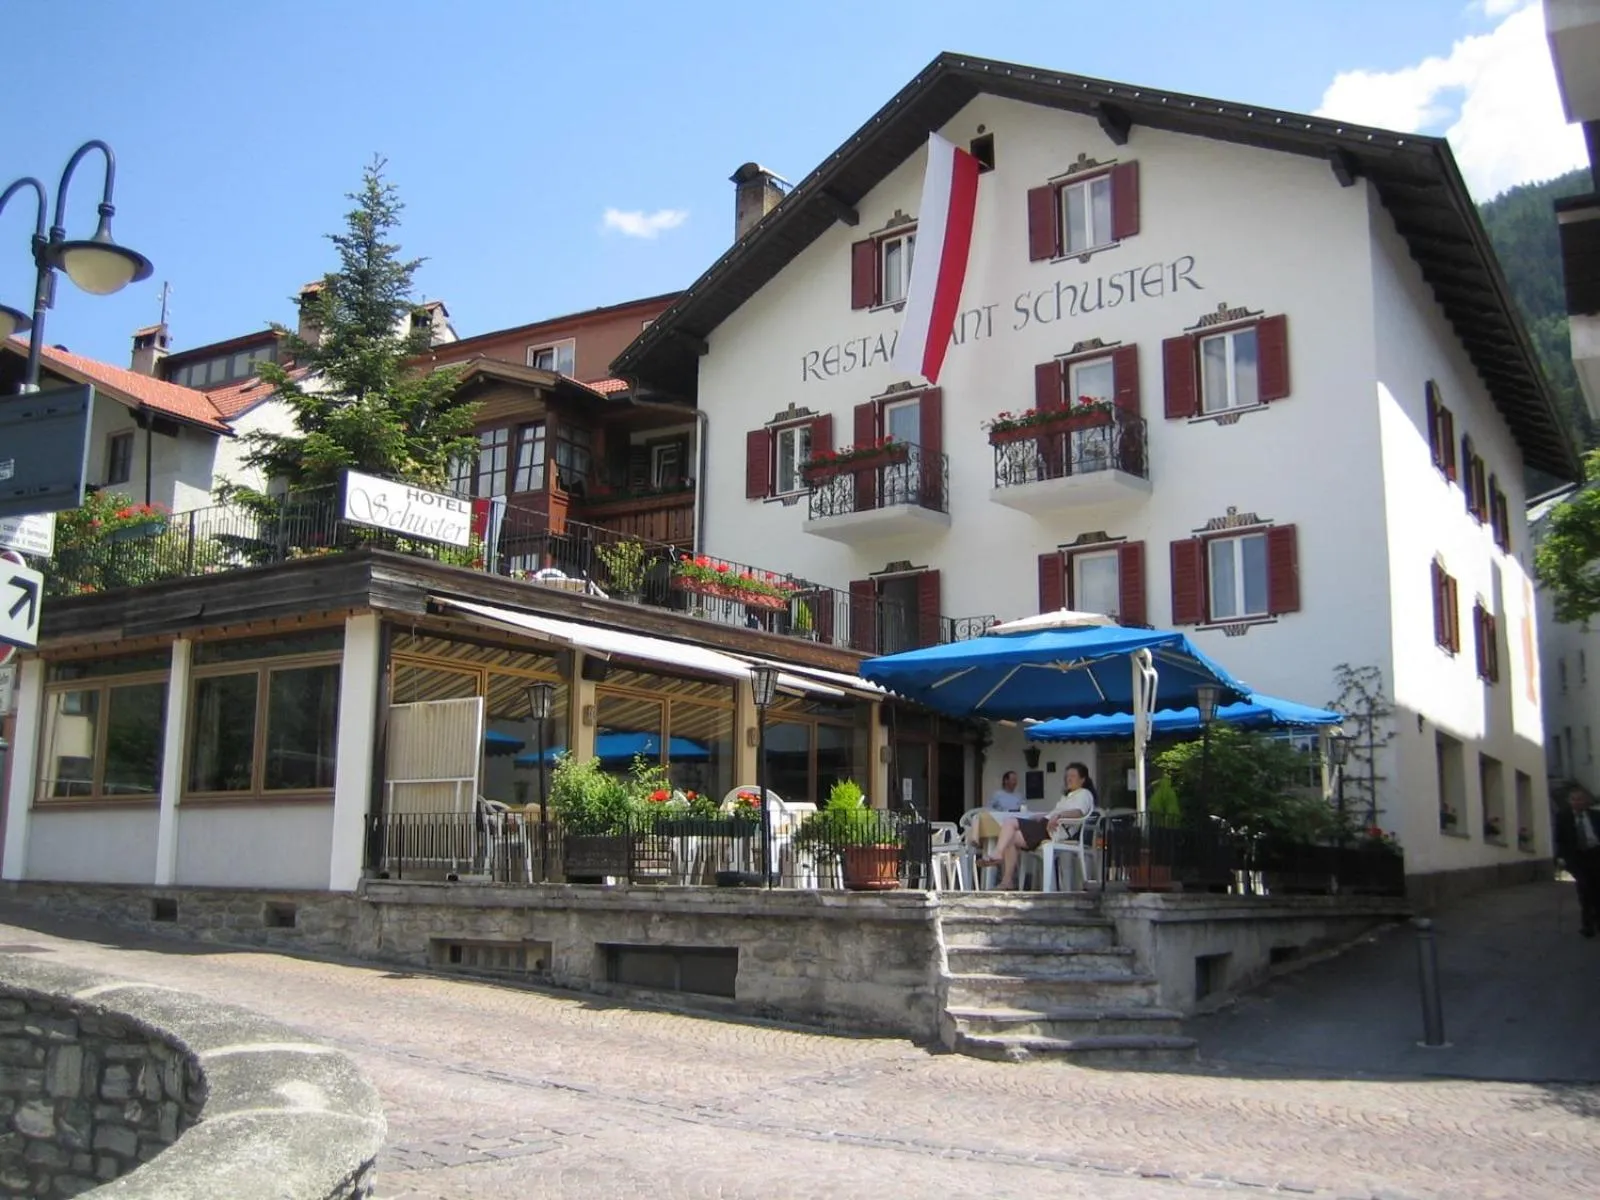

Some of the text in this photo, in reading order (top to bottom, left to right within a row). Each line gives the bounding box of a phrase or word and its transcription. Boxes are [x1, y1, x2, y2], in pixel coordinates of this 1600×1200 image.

[801, 304, 999, 382] RESTANT
[350, 487, 467, 542] Schuster
[406, 489, 467, 514] HOTEL
